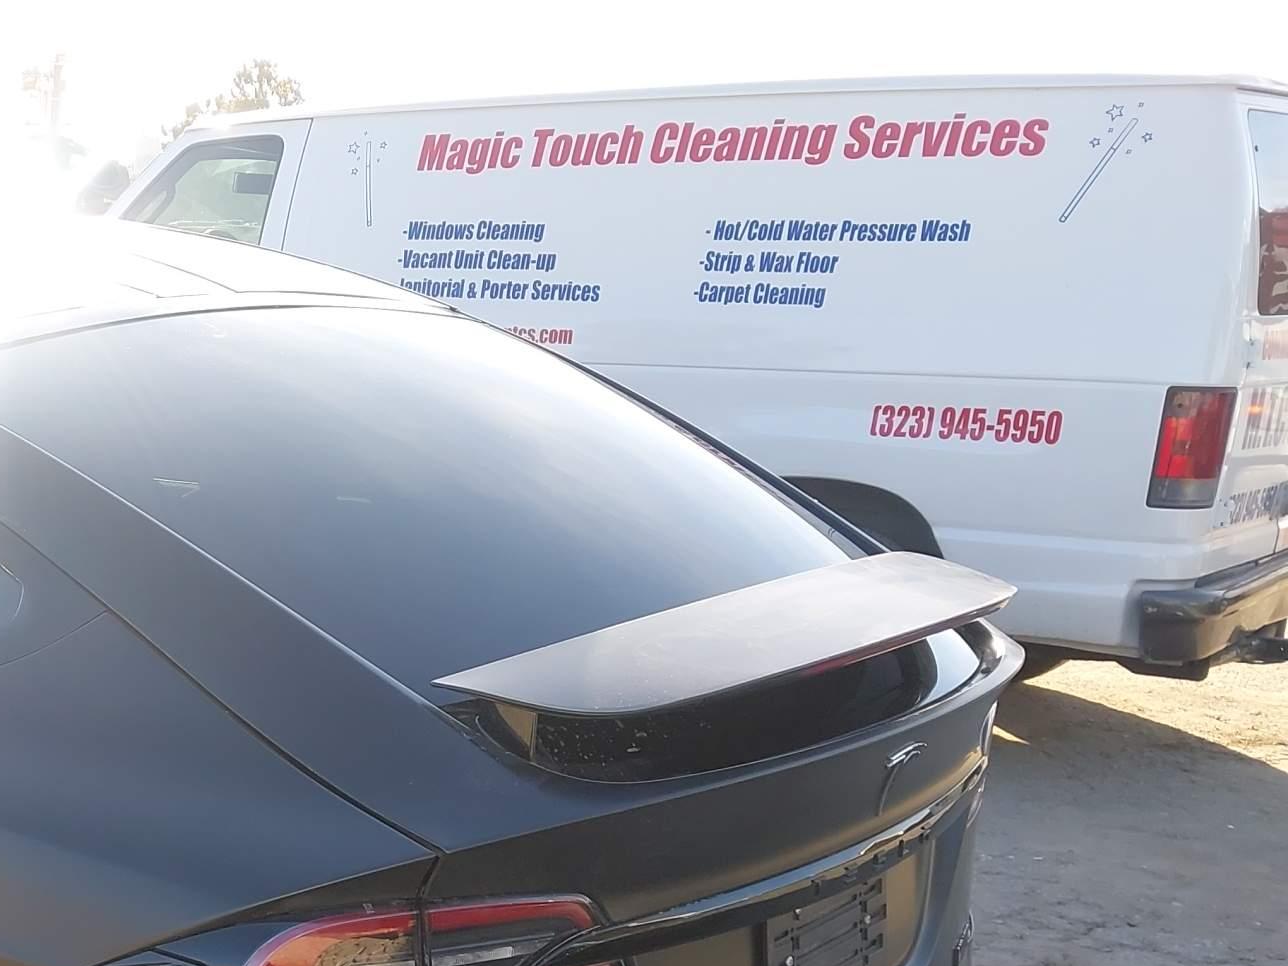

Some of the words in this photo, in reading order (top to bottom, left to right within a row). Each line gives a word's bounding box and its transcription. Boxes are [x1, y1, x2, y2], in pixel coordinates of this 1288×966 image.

[416, 131, 523, 175] Magic
[531, 124, 643, 168] Touch
[650, 119, 839, 166] Cleaning
[843, 113, 1049, 160] Services
[402, 221, 475, 241] -Windows
[476, 220, 545, 242] Cleaning
[787, 220, 838, 242] Water
[839, 220, 917, 242] Pressure
[920, 220, 971, 242] Wash
[397, 249, 454, 269] -Vacant
[454, 250, 485, 270] Unit
[486, 250, 557, 272] Clean-up
[699, 251, 741, 274] -Strip
[744, 254, 755, 272] &
[759, 251, 794, 273] Wax
[796, 252, 839, 274] Floor
[467, 282, 477, 299] &
[480, 280, 529, 300] Porter
[530, 280, 601, 302] Services
[693, 281, 751, 305] -Carpet
[753, 283, 826, 308] Cleaning
[870, 405, 935, 439] (323)
[938, 407, 1062, 445] 945-5950
